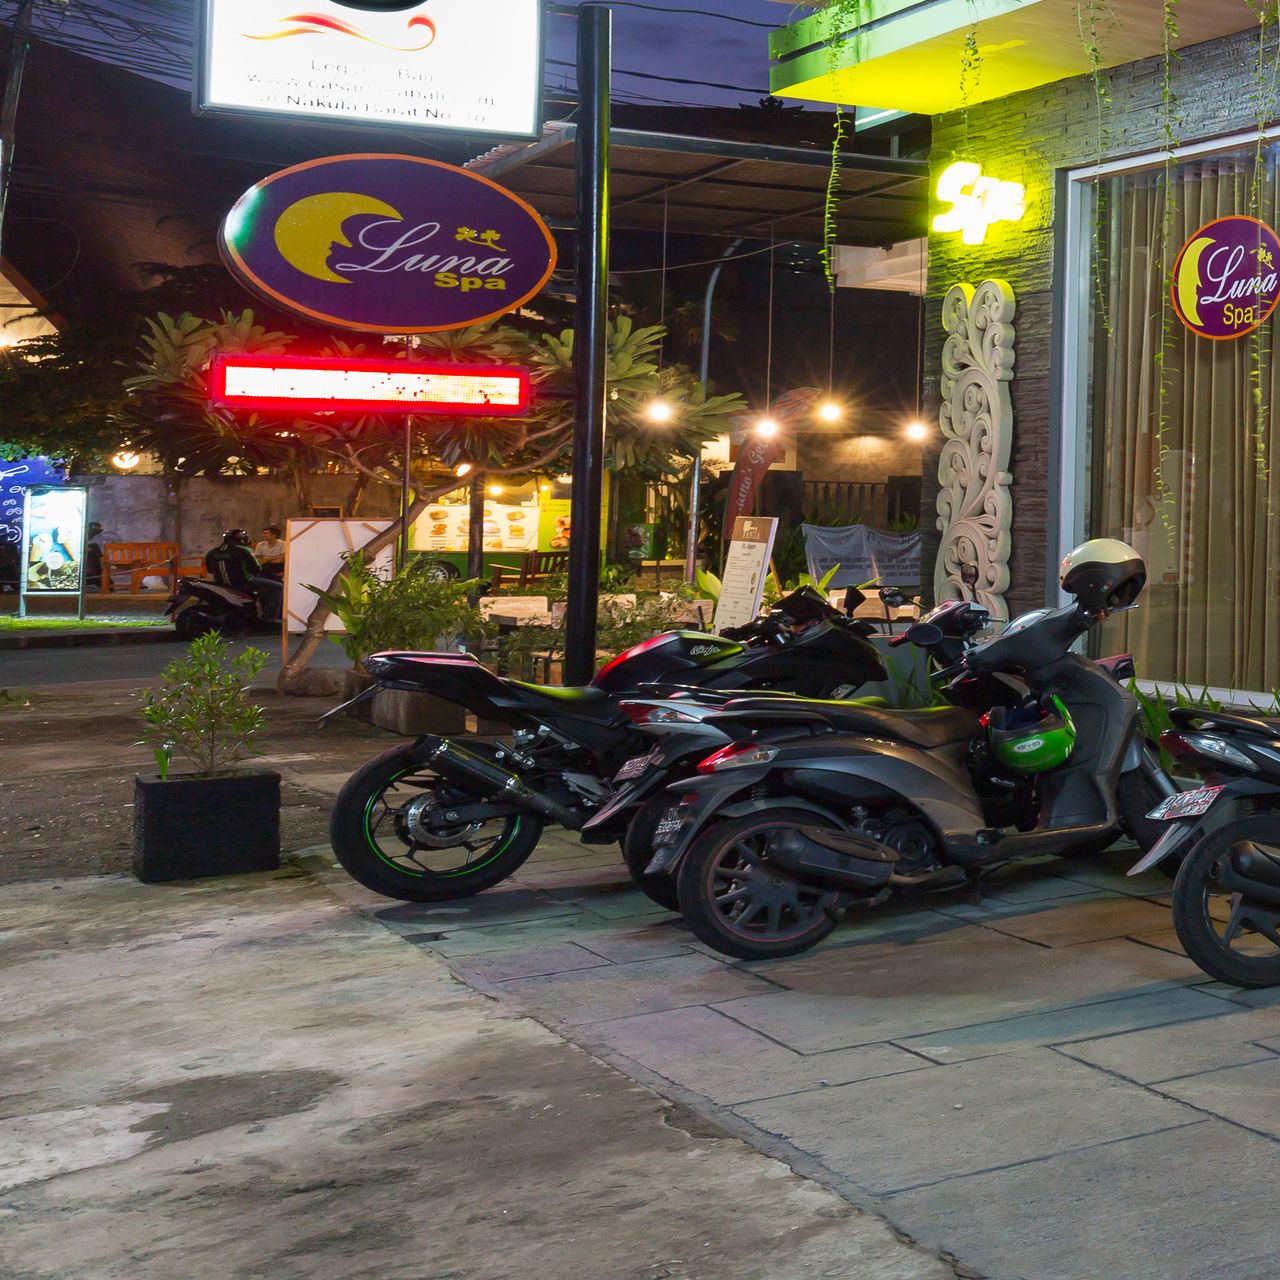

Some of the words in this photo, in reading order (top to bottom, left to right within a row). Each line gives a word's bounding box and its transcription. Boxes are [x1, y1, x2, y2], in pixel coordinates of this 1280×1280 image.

[286, 94, 358, 113] Nakula
[335, 219, 516, 276] Luna
[433, 272, 507, 292] Spa
[1200, 245, 1278, 304] Luna
[1222, 303, 1254, 329] Spa
